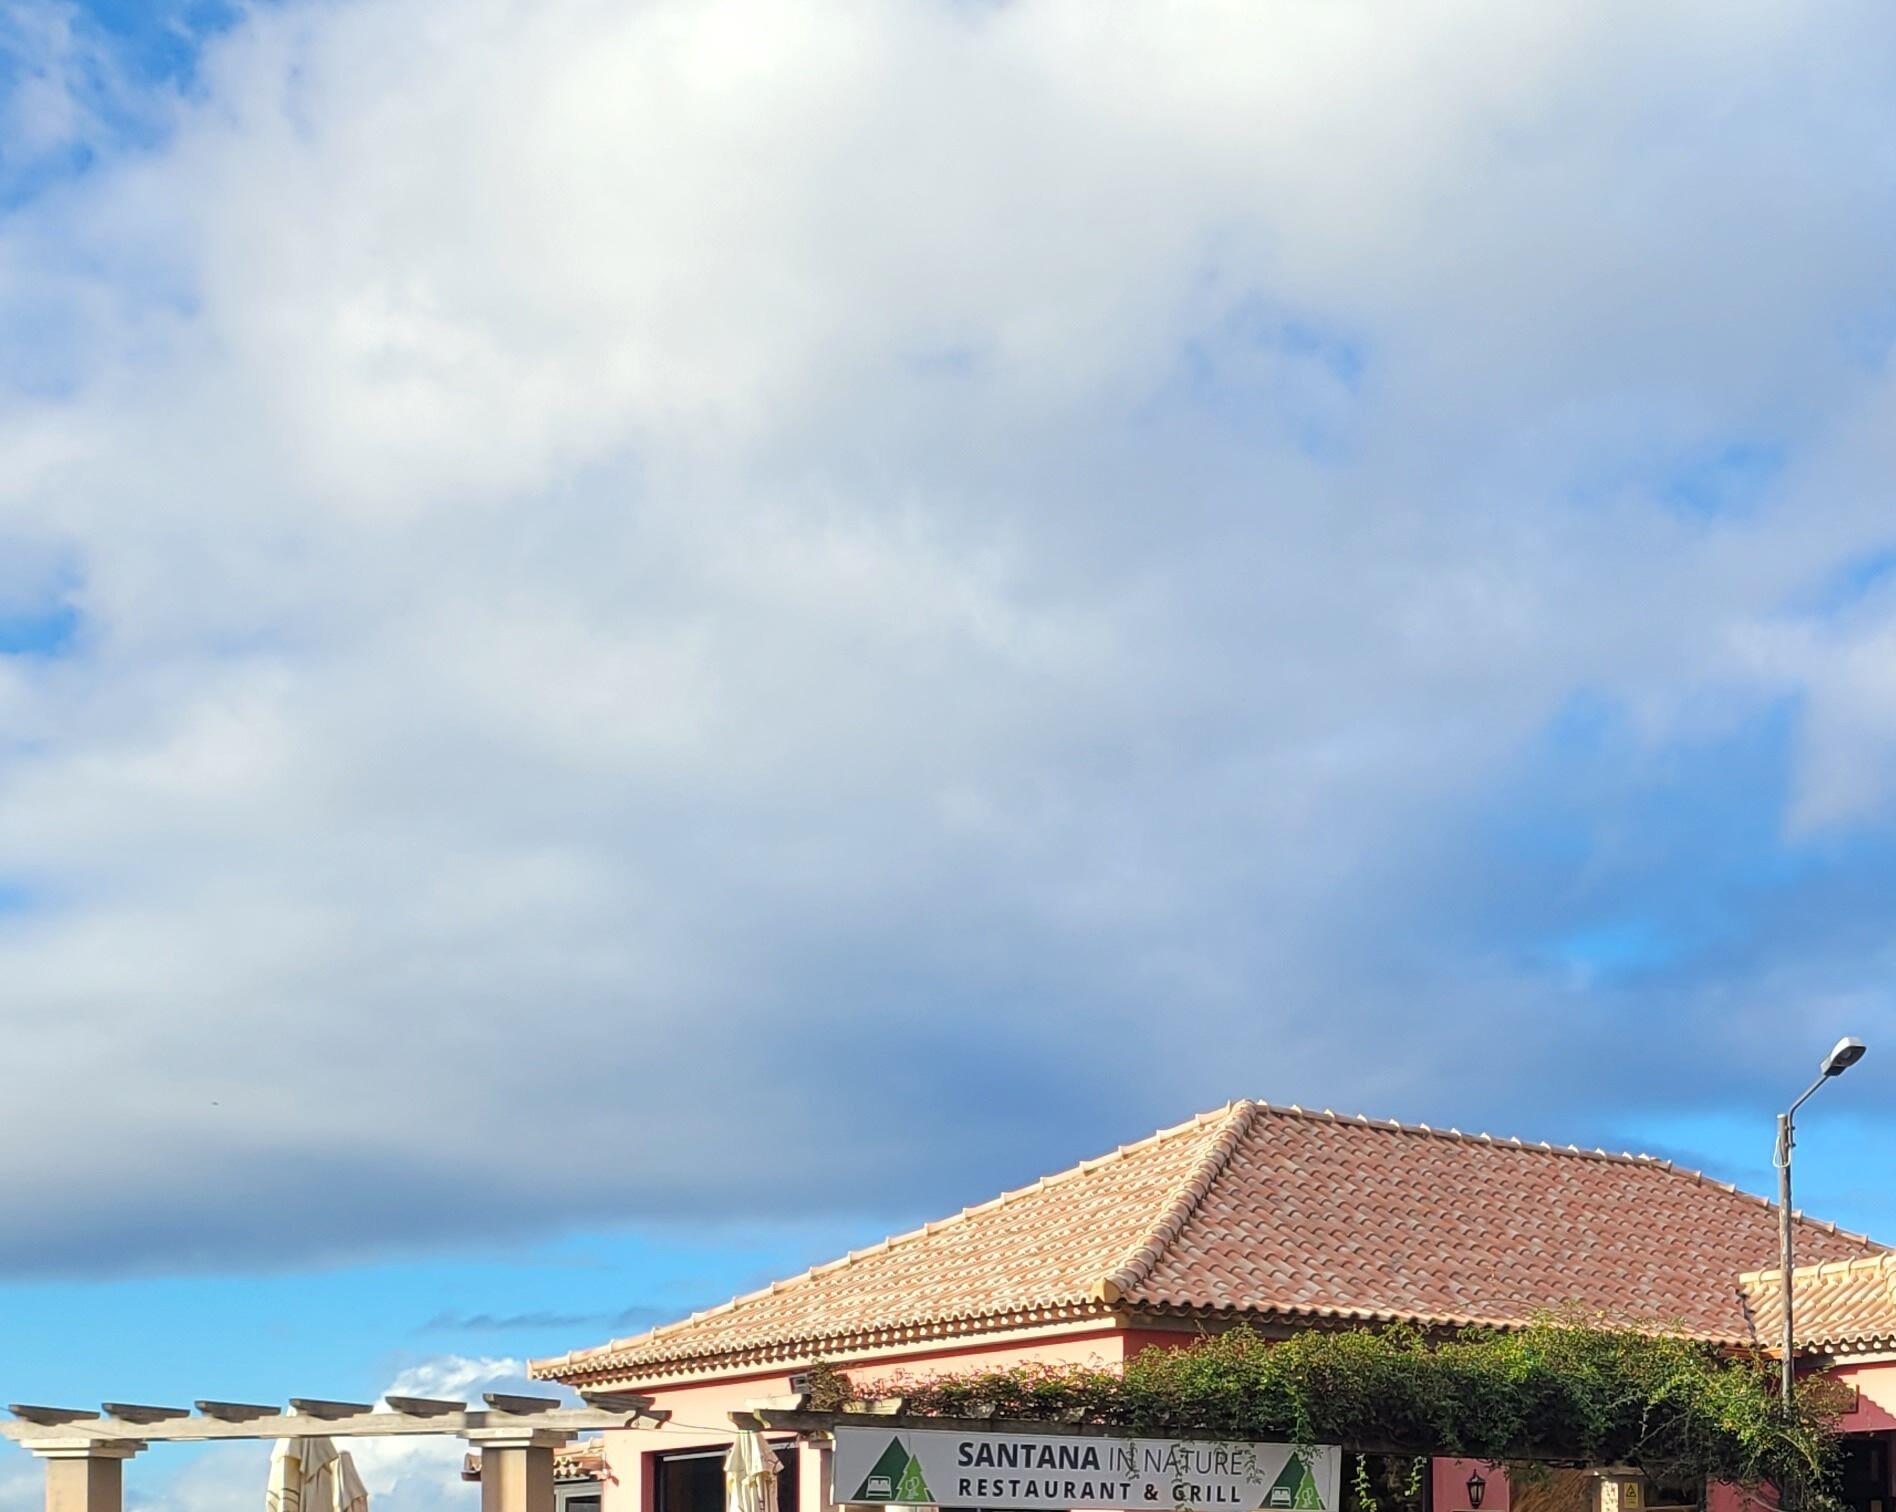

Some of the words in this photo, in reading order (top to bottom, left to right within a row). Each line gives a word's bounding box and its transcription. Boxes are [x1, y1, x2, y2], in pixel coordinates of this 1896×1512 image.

[957, 1442, 1100, 1471] SANTANA
[1108, 1447, 1135, 1472] IN
[1144, 1449, 1243, 1475] NATURE
[958, 1478, 1132, 1501] RESTAURANT
[1143, 1483, 1159, 1501] &
[1172, 1484, 1241, 1502] GRILL
